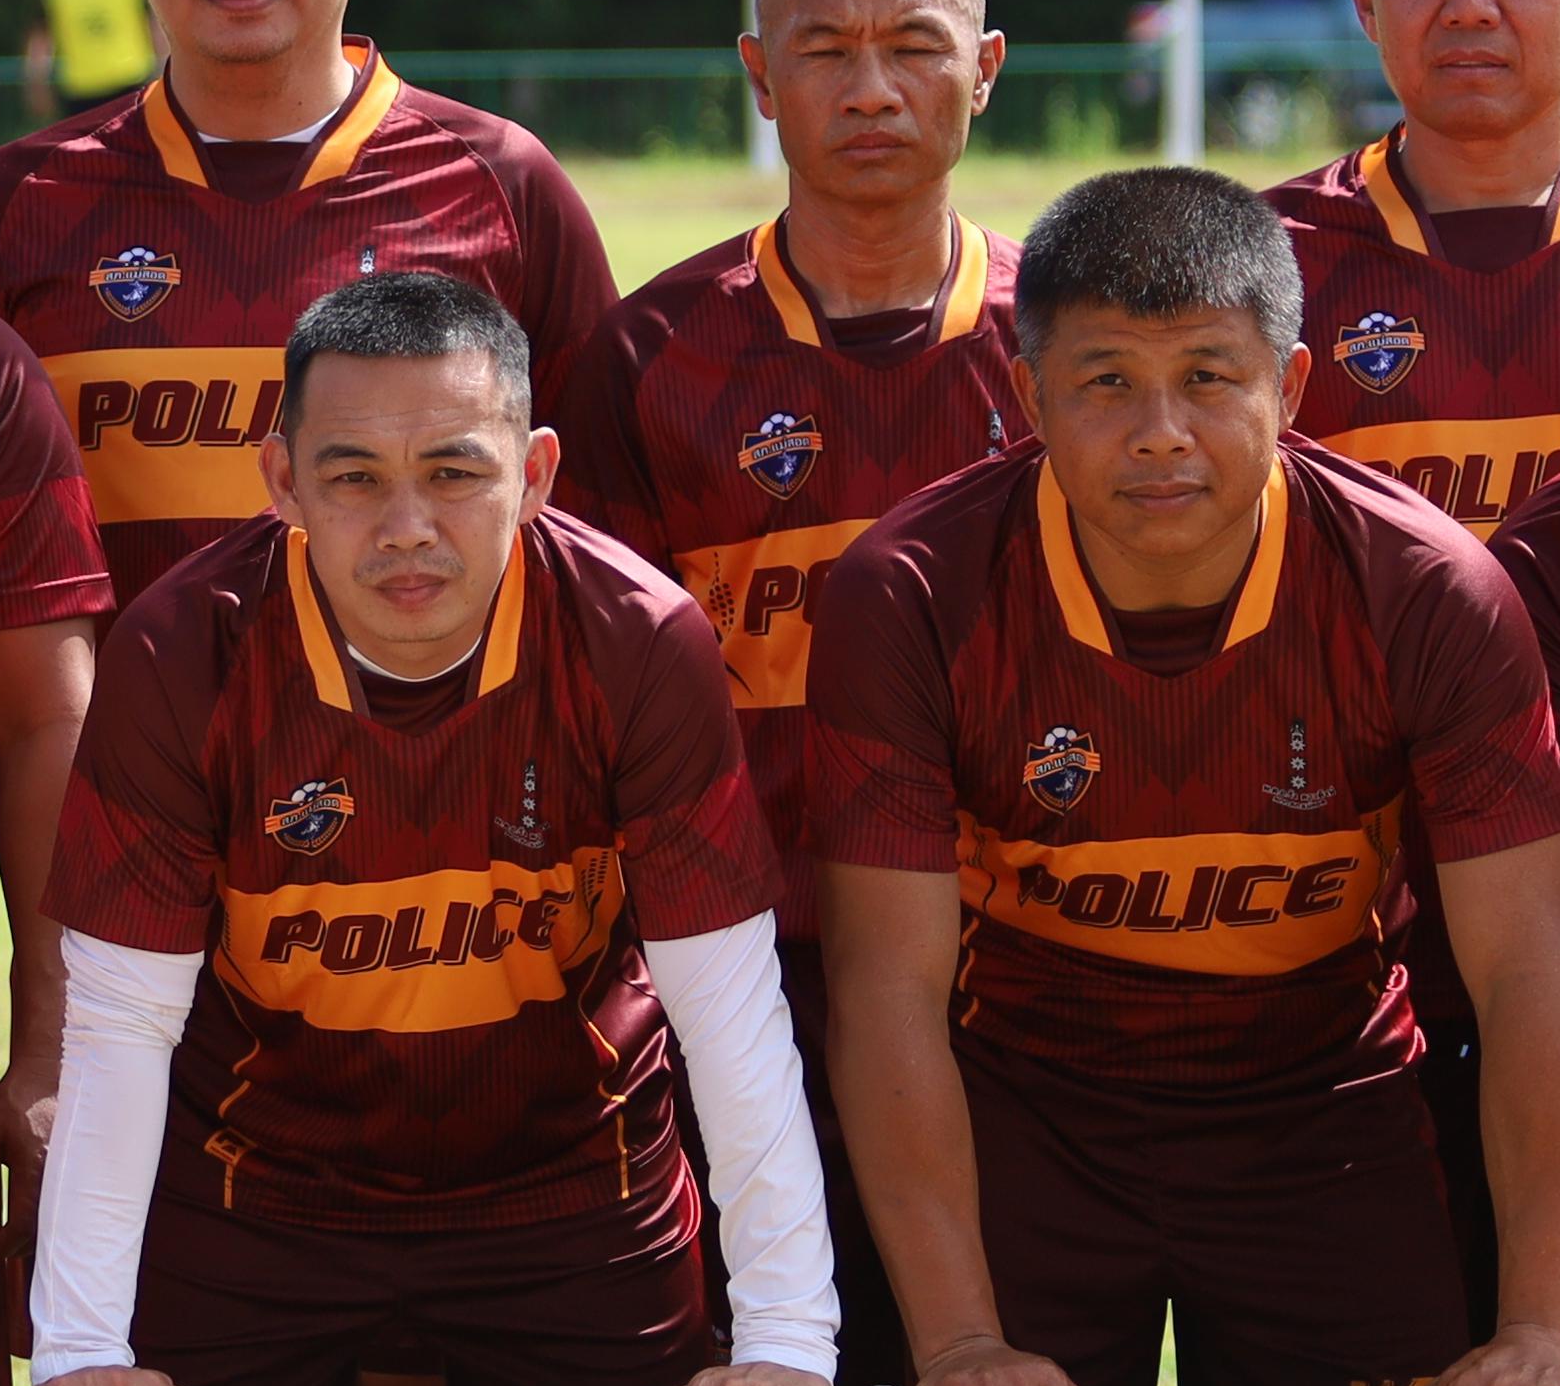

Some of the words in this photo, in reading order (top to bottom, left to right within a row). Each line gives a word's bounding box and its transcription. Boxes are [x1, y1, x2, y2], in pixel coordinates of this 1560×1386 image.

[77, 379, 289, 451] POLI
[261, 888, 577, 974] POLICE
[1018, 856, 1361, 933] POLICE
